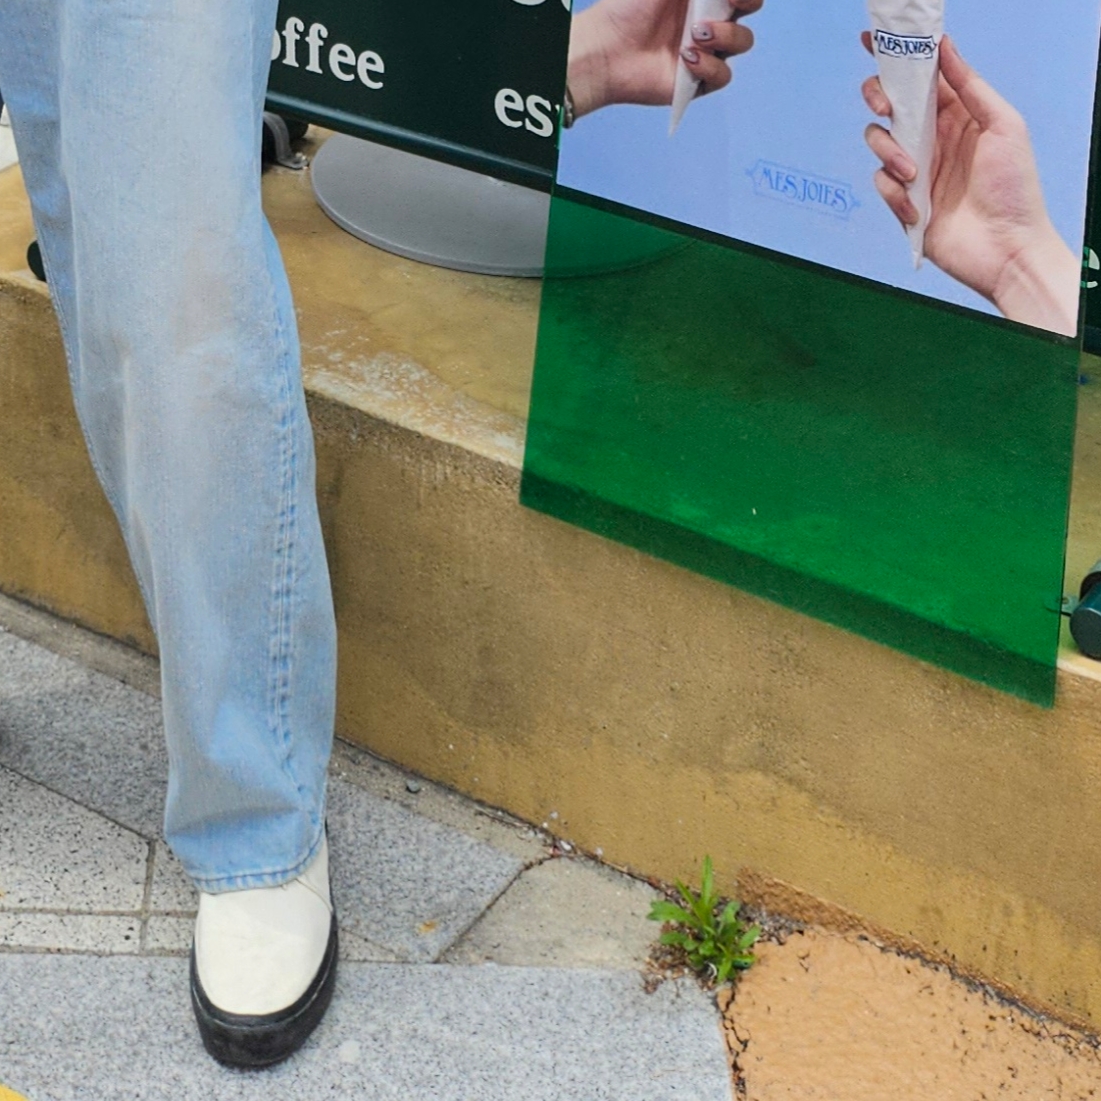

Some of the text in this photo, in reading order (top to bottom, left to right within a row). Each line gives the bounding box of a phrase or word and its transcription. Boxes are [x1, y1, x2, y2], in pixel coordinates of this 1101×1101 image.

[494, 87, 563, 138] es
[758, 167, 798, 199] MES
[798, 178, 848, 213] JOIES
